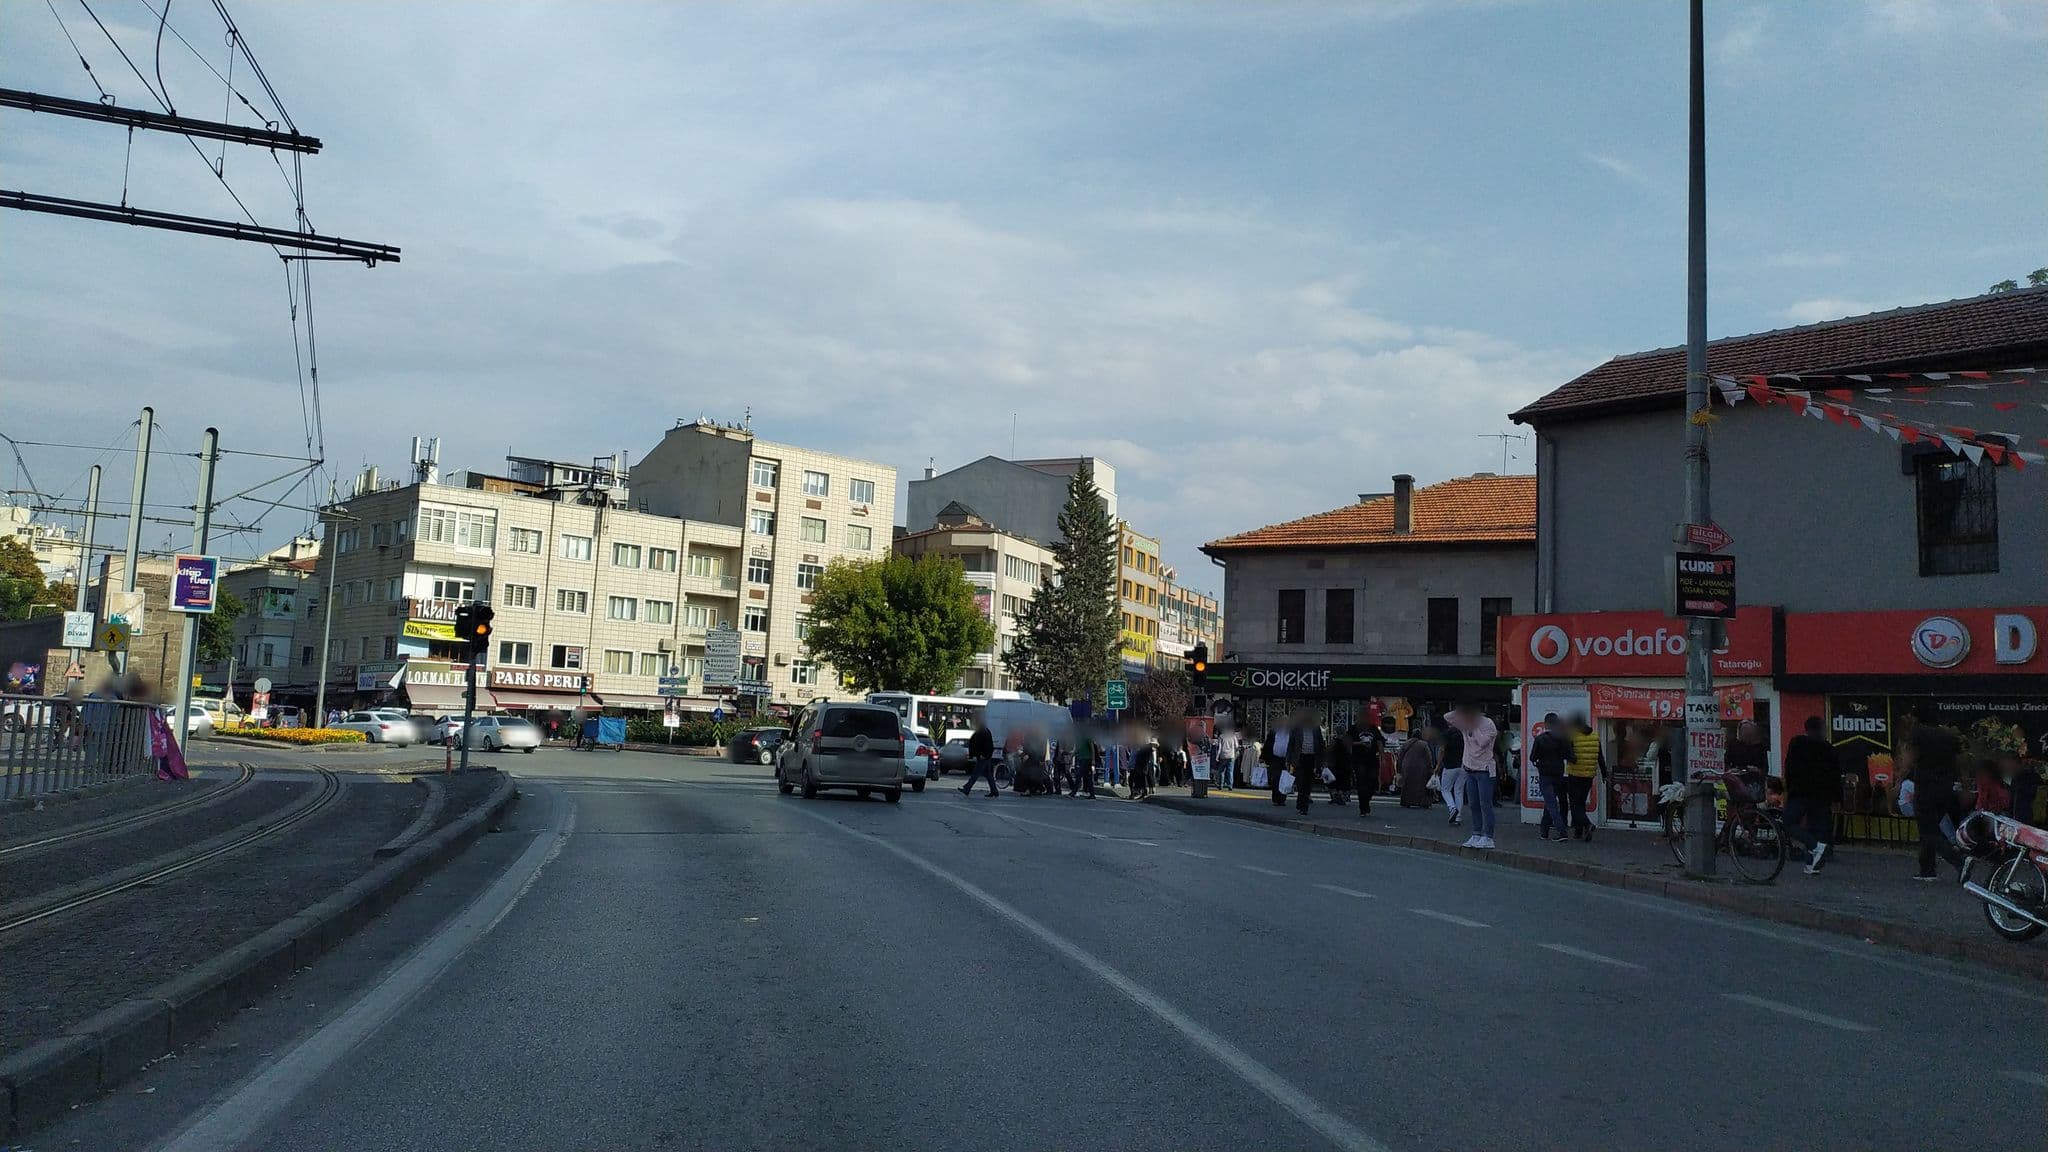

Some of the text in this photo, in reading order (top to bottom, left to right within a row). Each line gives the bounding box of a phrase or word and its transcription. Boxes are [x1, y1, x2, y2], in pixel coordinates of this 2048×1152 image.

[1717, 659, 1762, 671] Tataroğlu
[407, 670, 451, 684] LOKMAN
[495, 670, 541, 686] PARİS
[1251, 669, 1331, 691] objektif
